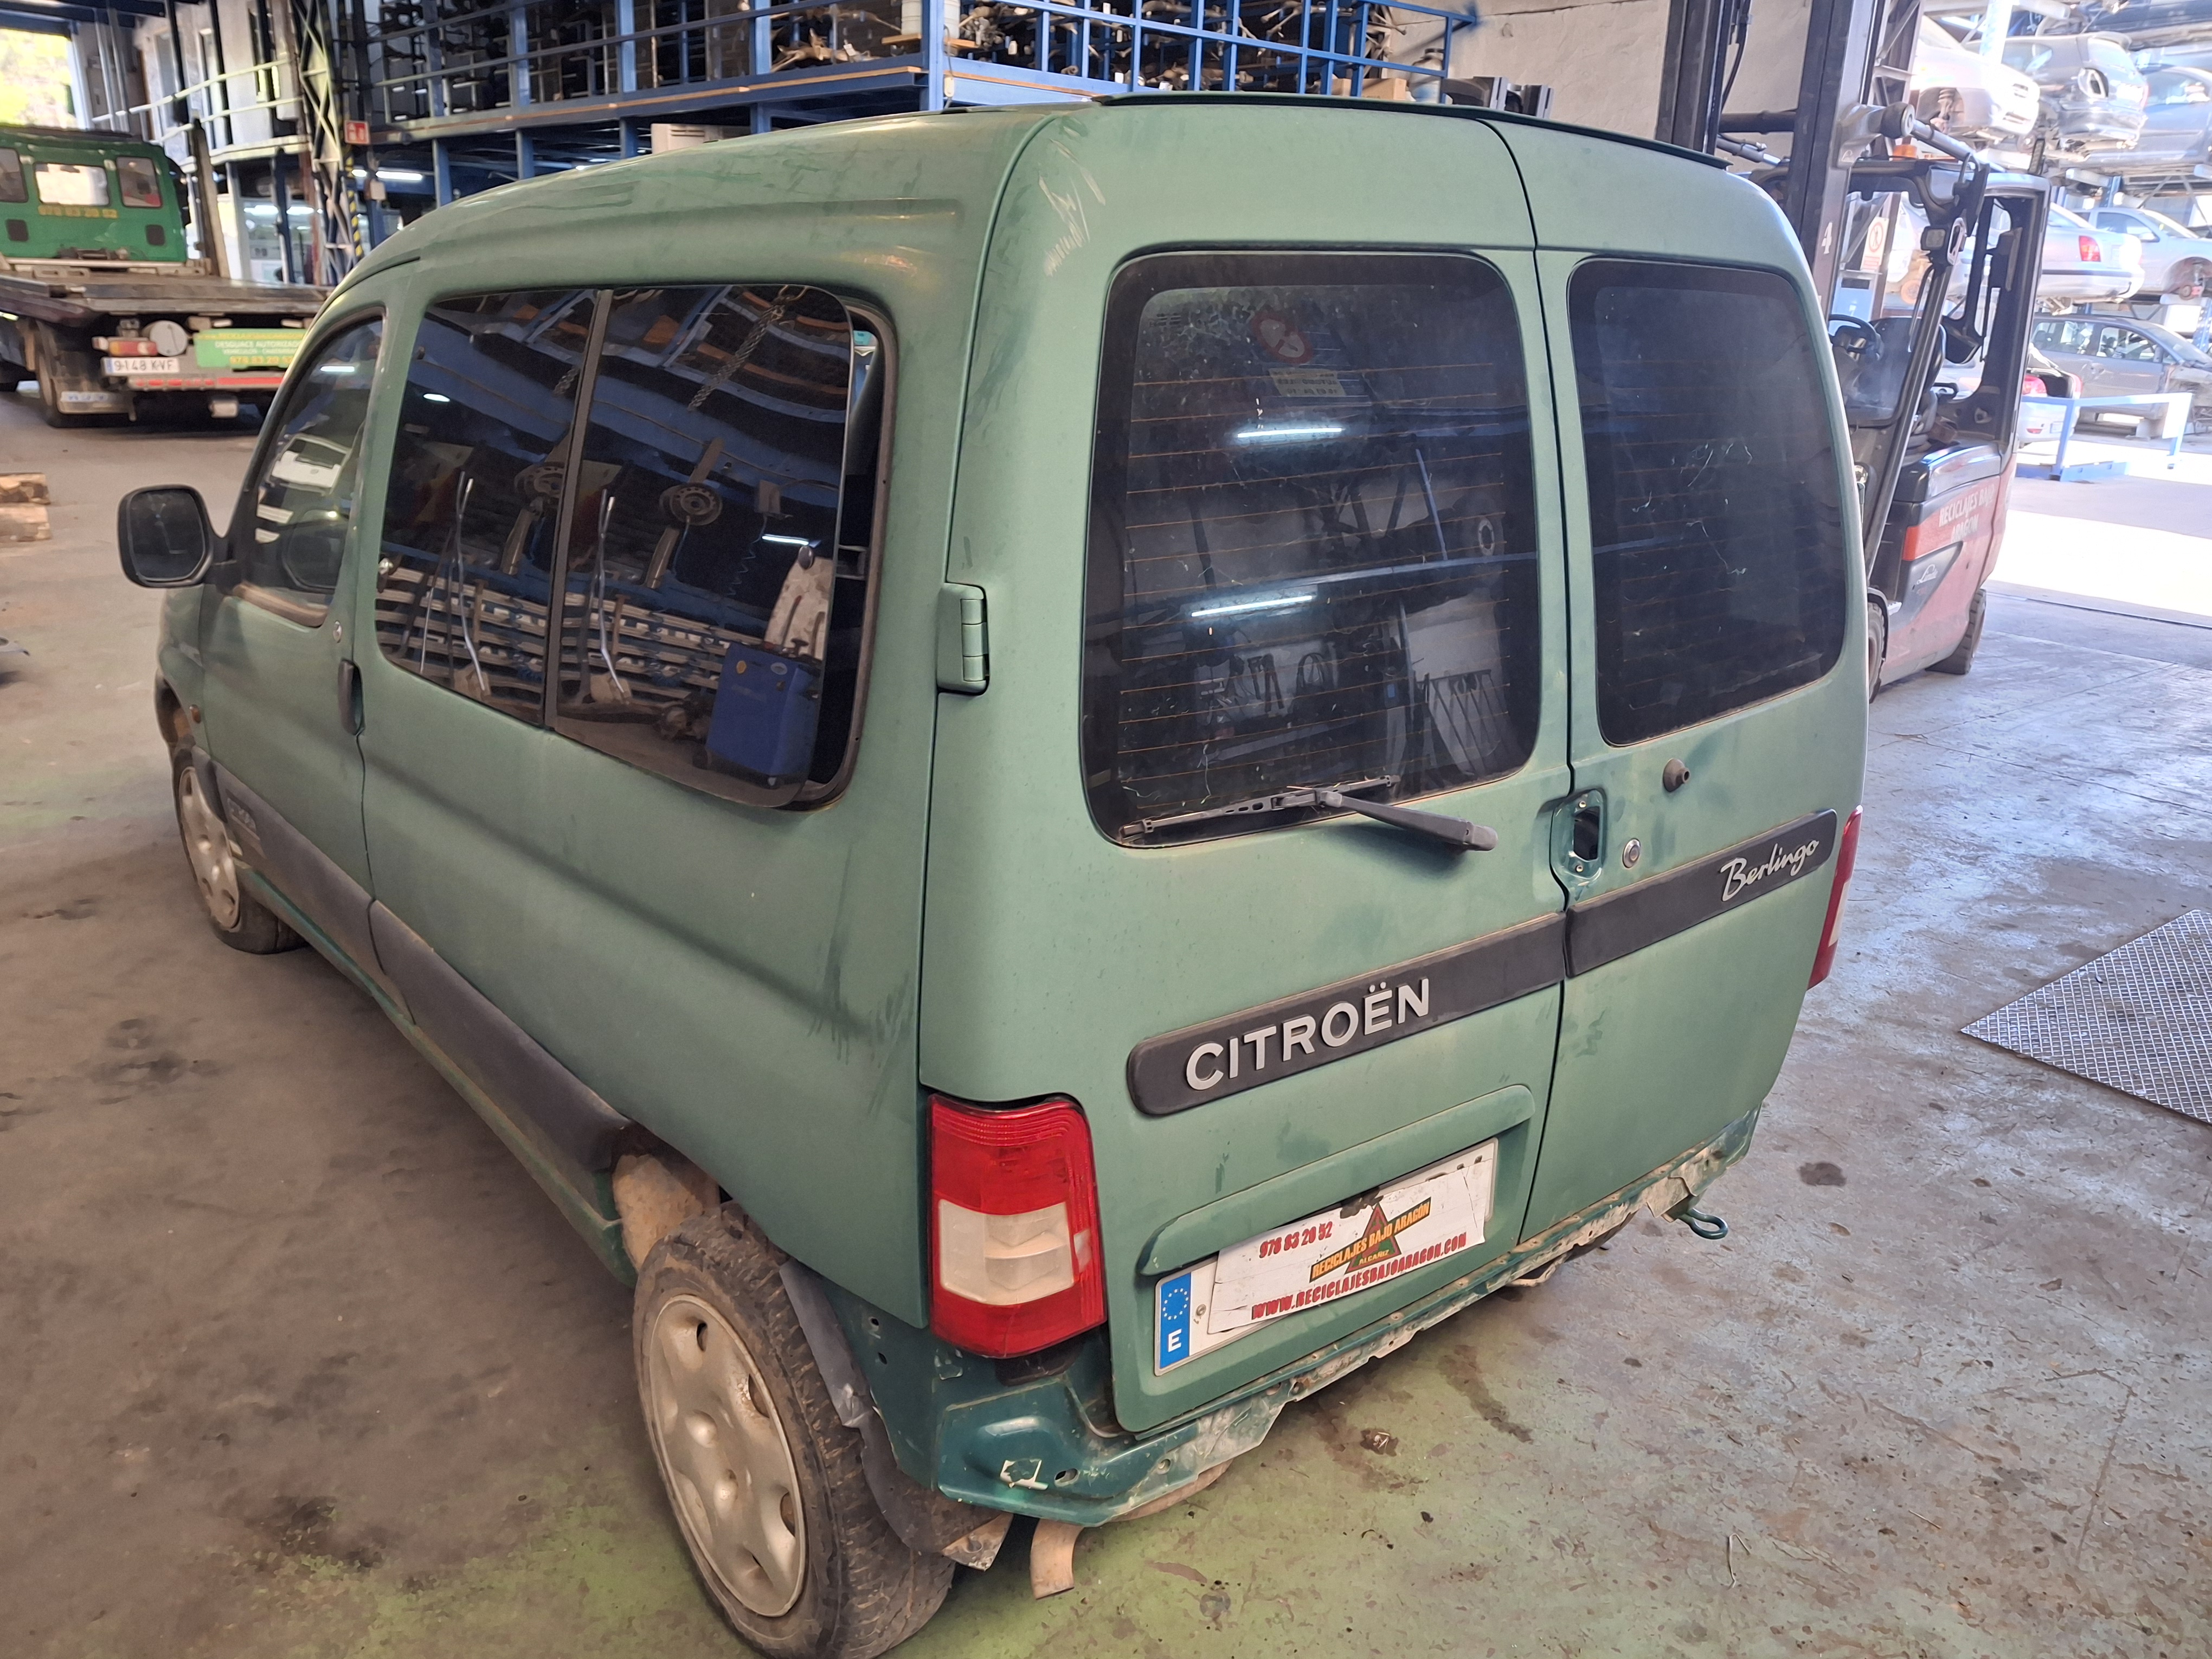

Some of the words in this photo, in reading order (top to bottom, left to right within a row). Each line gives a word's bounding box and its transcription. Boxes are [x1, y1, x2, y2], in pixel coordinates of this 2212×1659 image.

[114, 360, 146, 370] 9148
[1939, 491, 1979, 528] RECICLAJES
[1979, 484, 1995, 507] BAJO
[1720, 840, 1819, 902] Berlingo
[1185, 978, 1430, 1091] CITROËN
[1259, 1237, 1282, 1258] 978
[1284, 1231, 1300, 1251] 83
[1301, 1226, 1316, 1246] 20
[1318, 1221, 1333, 1240] 52
[1312, 1237, 1367, 1278] RECICLAJES
[1368, 1223, 1393, 1248] BAJO
[1393, 1201, 1430, 1233] ARAGÓN
[1359, 1249, 1390, 1265] ALCAÑIZ
[1251, 1231, 1467, 1320] WWW.RECICLAJESBAJOARAGON.COM
[1167, 1328, 1182, 1352] E
